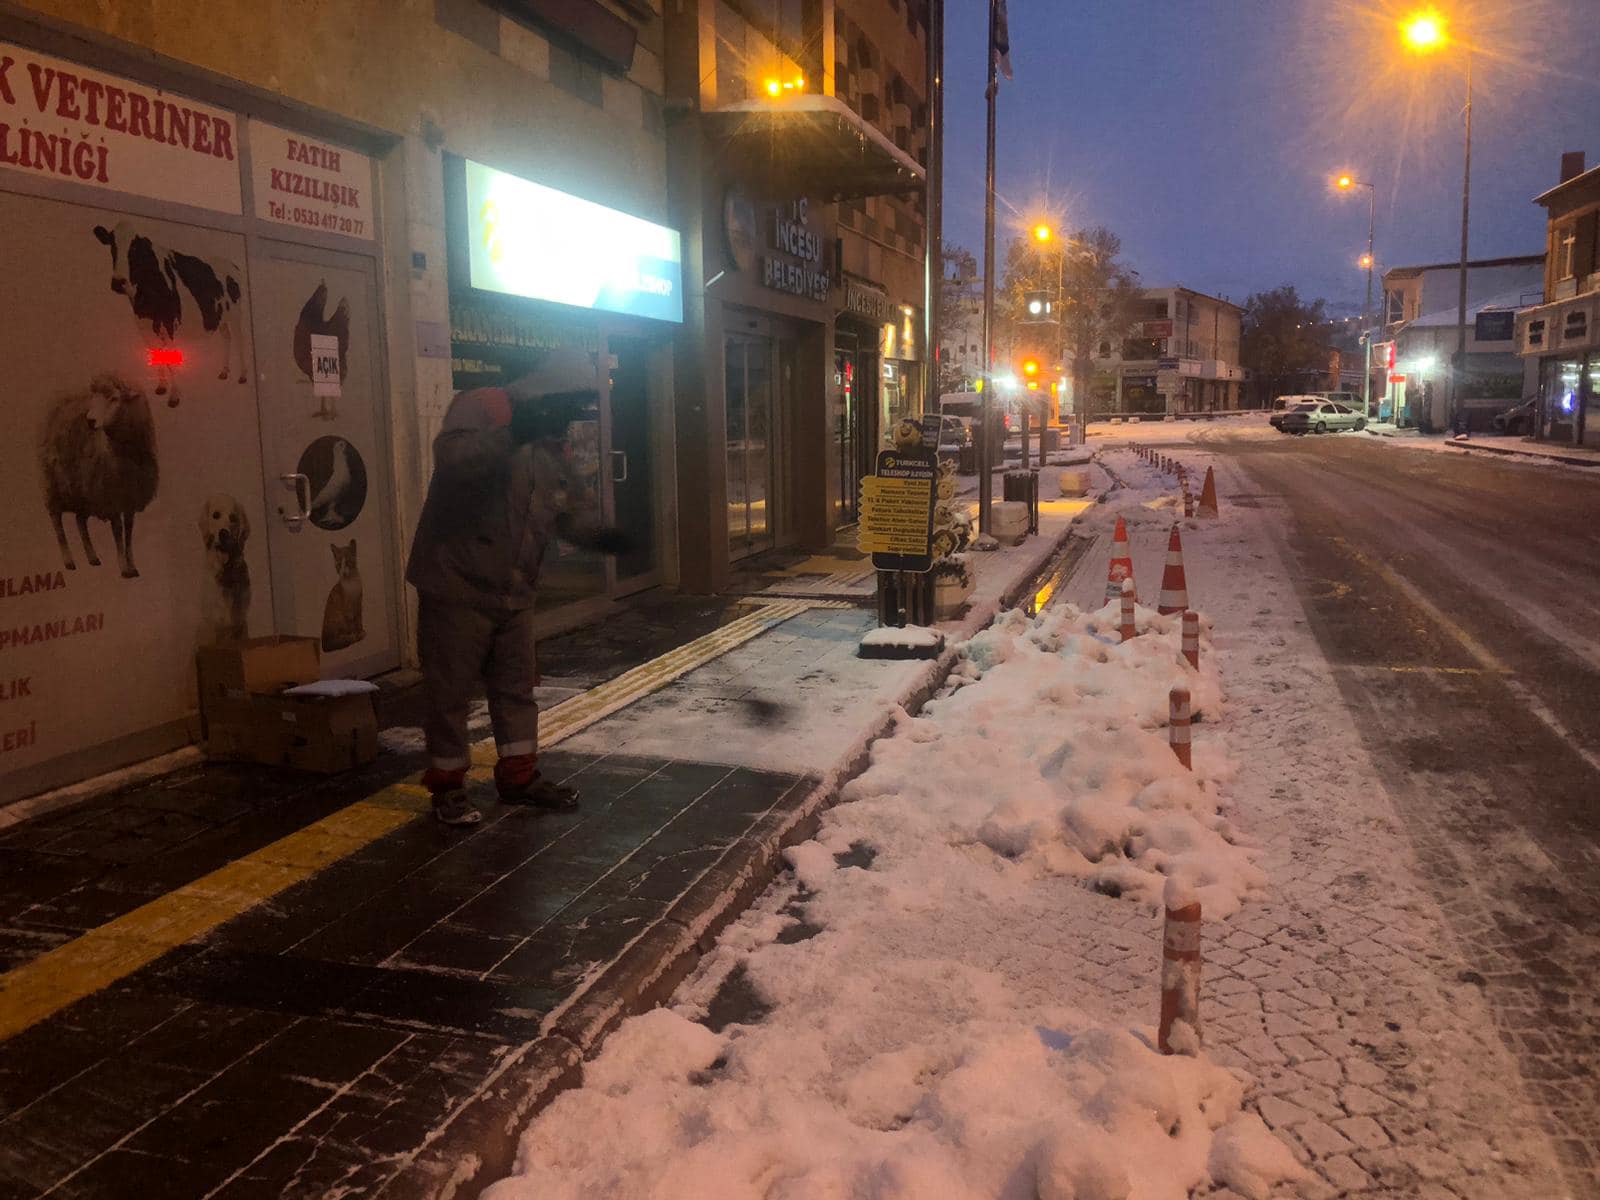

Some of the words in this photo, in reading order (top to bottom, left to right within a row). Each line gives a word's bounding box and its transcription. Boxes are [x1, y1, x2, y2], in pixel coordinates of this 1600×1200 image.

[27, 63, 234, 161] VETERİNER
[270, 167, 361, 209] KIZILIŞIK
[293, 207, 320, 226] 0533
[321, 213, 339, 230] 417
[775, 207, 820, 263] İNCESU
[765, 255, 830, 303] BELEDİYESİ
[316, 355, 340, 379] AÇIK
[880, 468, 911, 478] TELESHOP
[895, 459, 931, 468] TURKCELL
